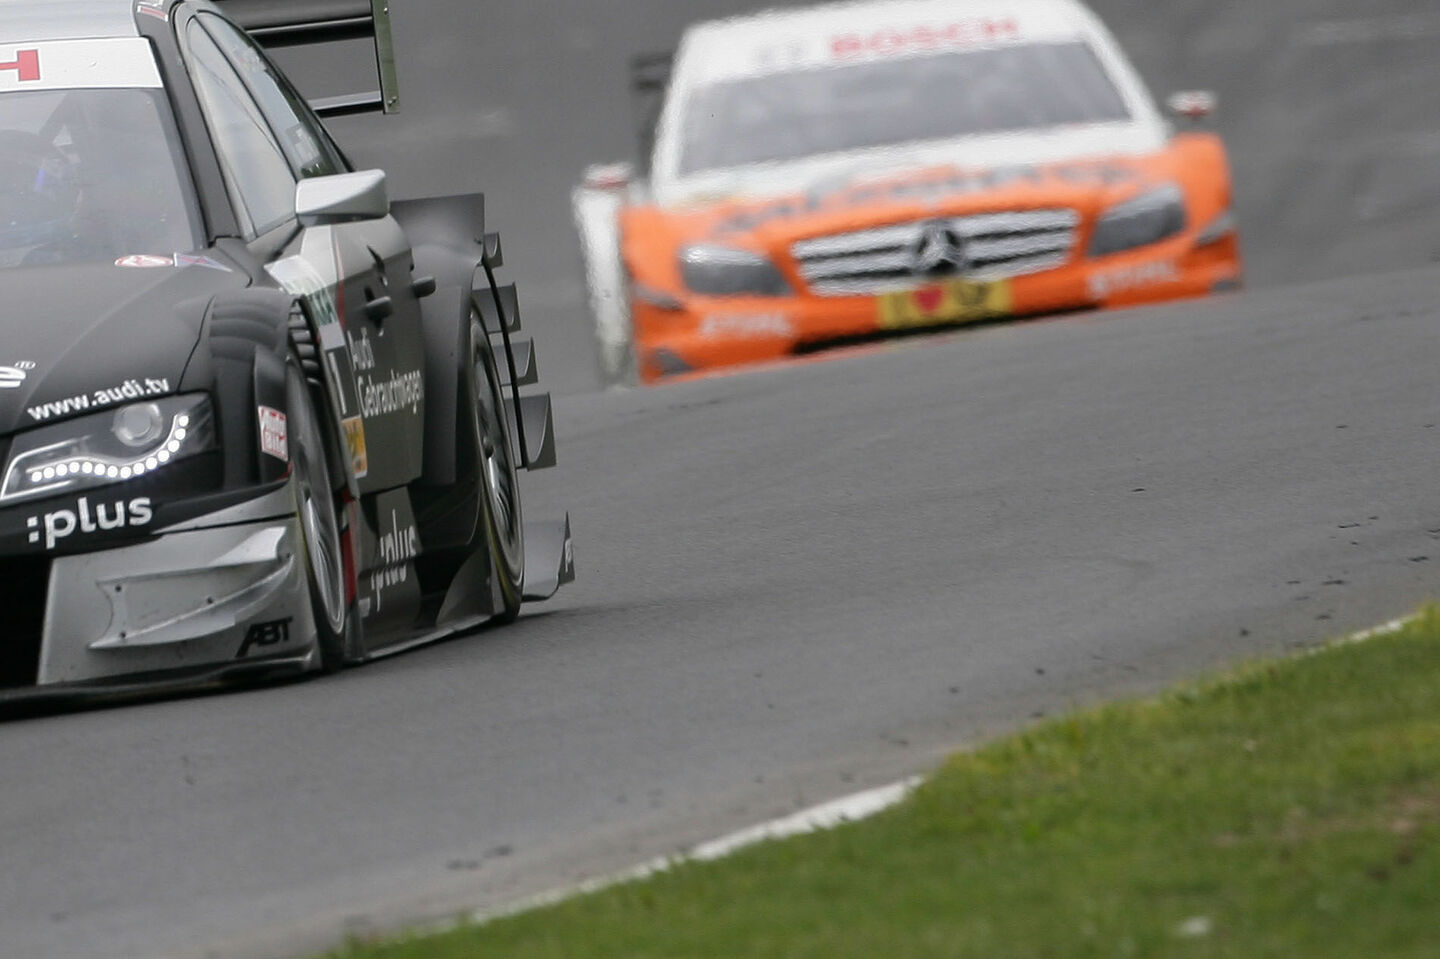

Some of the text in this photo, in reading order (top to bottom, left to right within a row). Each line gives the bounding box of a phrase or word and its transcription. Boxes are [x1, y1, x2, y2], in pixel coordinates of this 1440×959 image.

[27, 377, 170, 421] www.audi.tv
[26, 497, 153, 550] :plus
[235, 615, 293, 658] ABT
